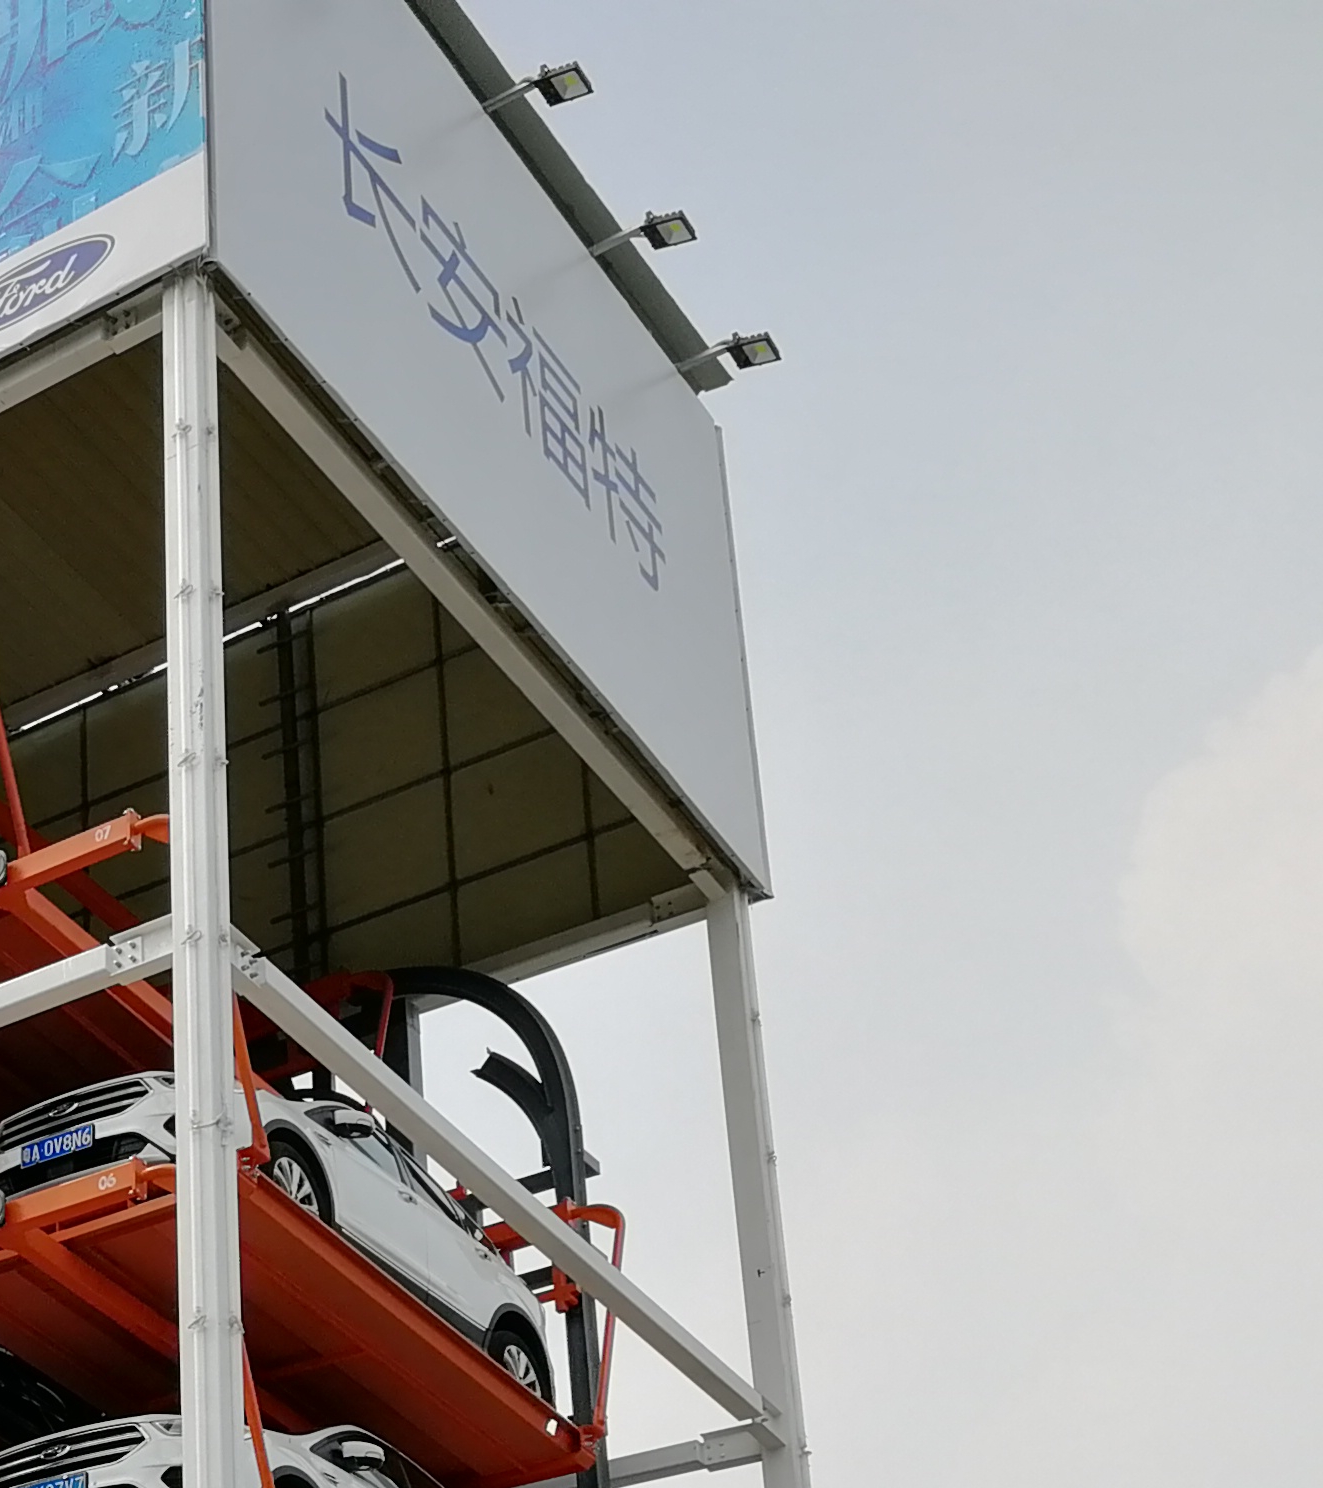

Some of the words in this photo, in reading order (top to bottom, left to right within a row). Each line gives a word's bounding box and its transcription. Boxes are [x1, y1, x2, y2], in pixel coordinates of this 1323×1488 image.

[325, 71, 666, 591] 长安福特
[95, 824, 112, 842] 07
[98, 1172, 117, 1191] 06
